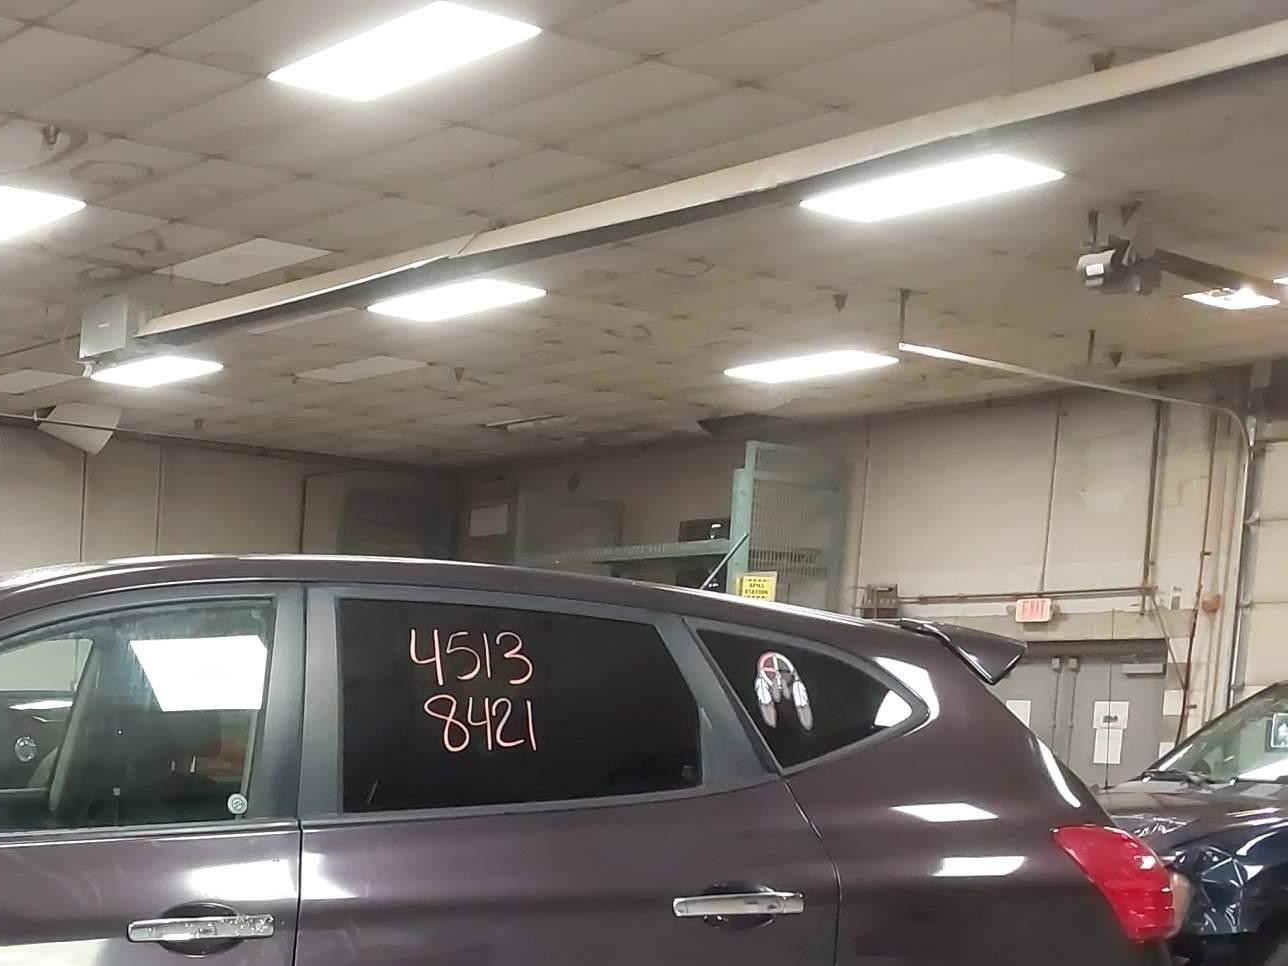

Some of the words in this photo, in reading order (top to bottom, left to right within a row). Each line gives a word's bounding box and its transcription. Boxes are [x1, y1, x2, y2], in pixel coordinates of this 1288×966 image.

[1022, 600, 1047, 617] EXIT
[410, 629, 533, 685] 4513
[424, 694, 537, 752] 8421
